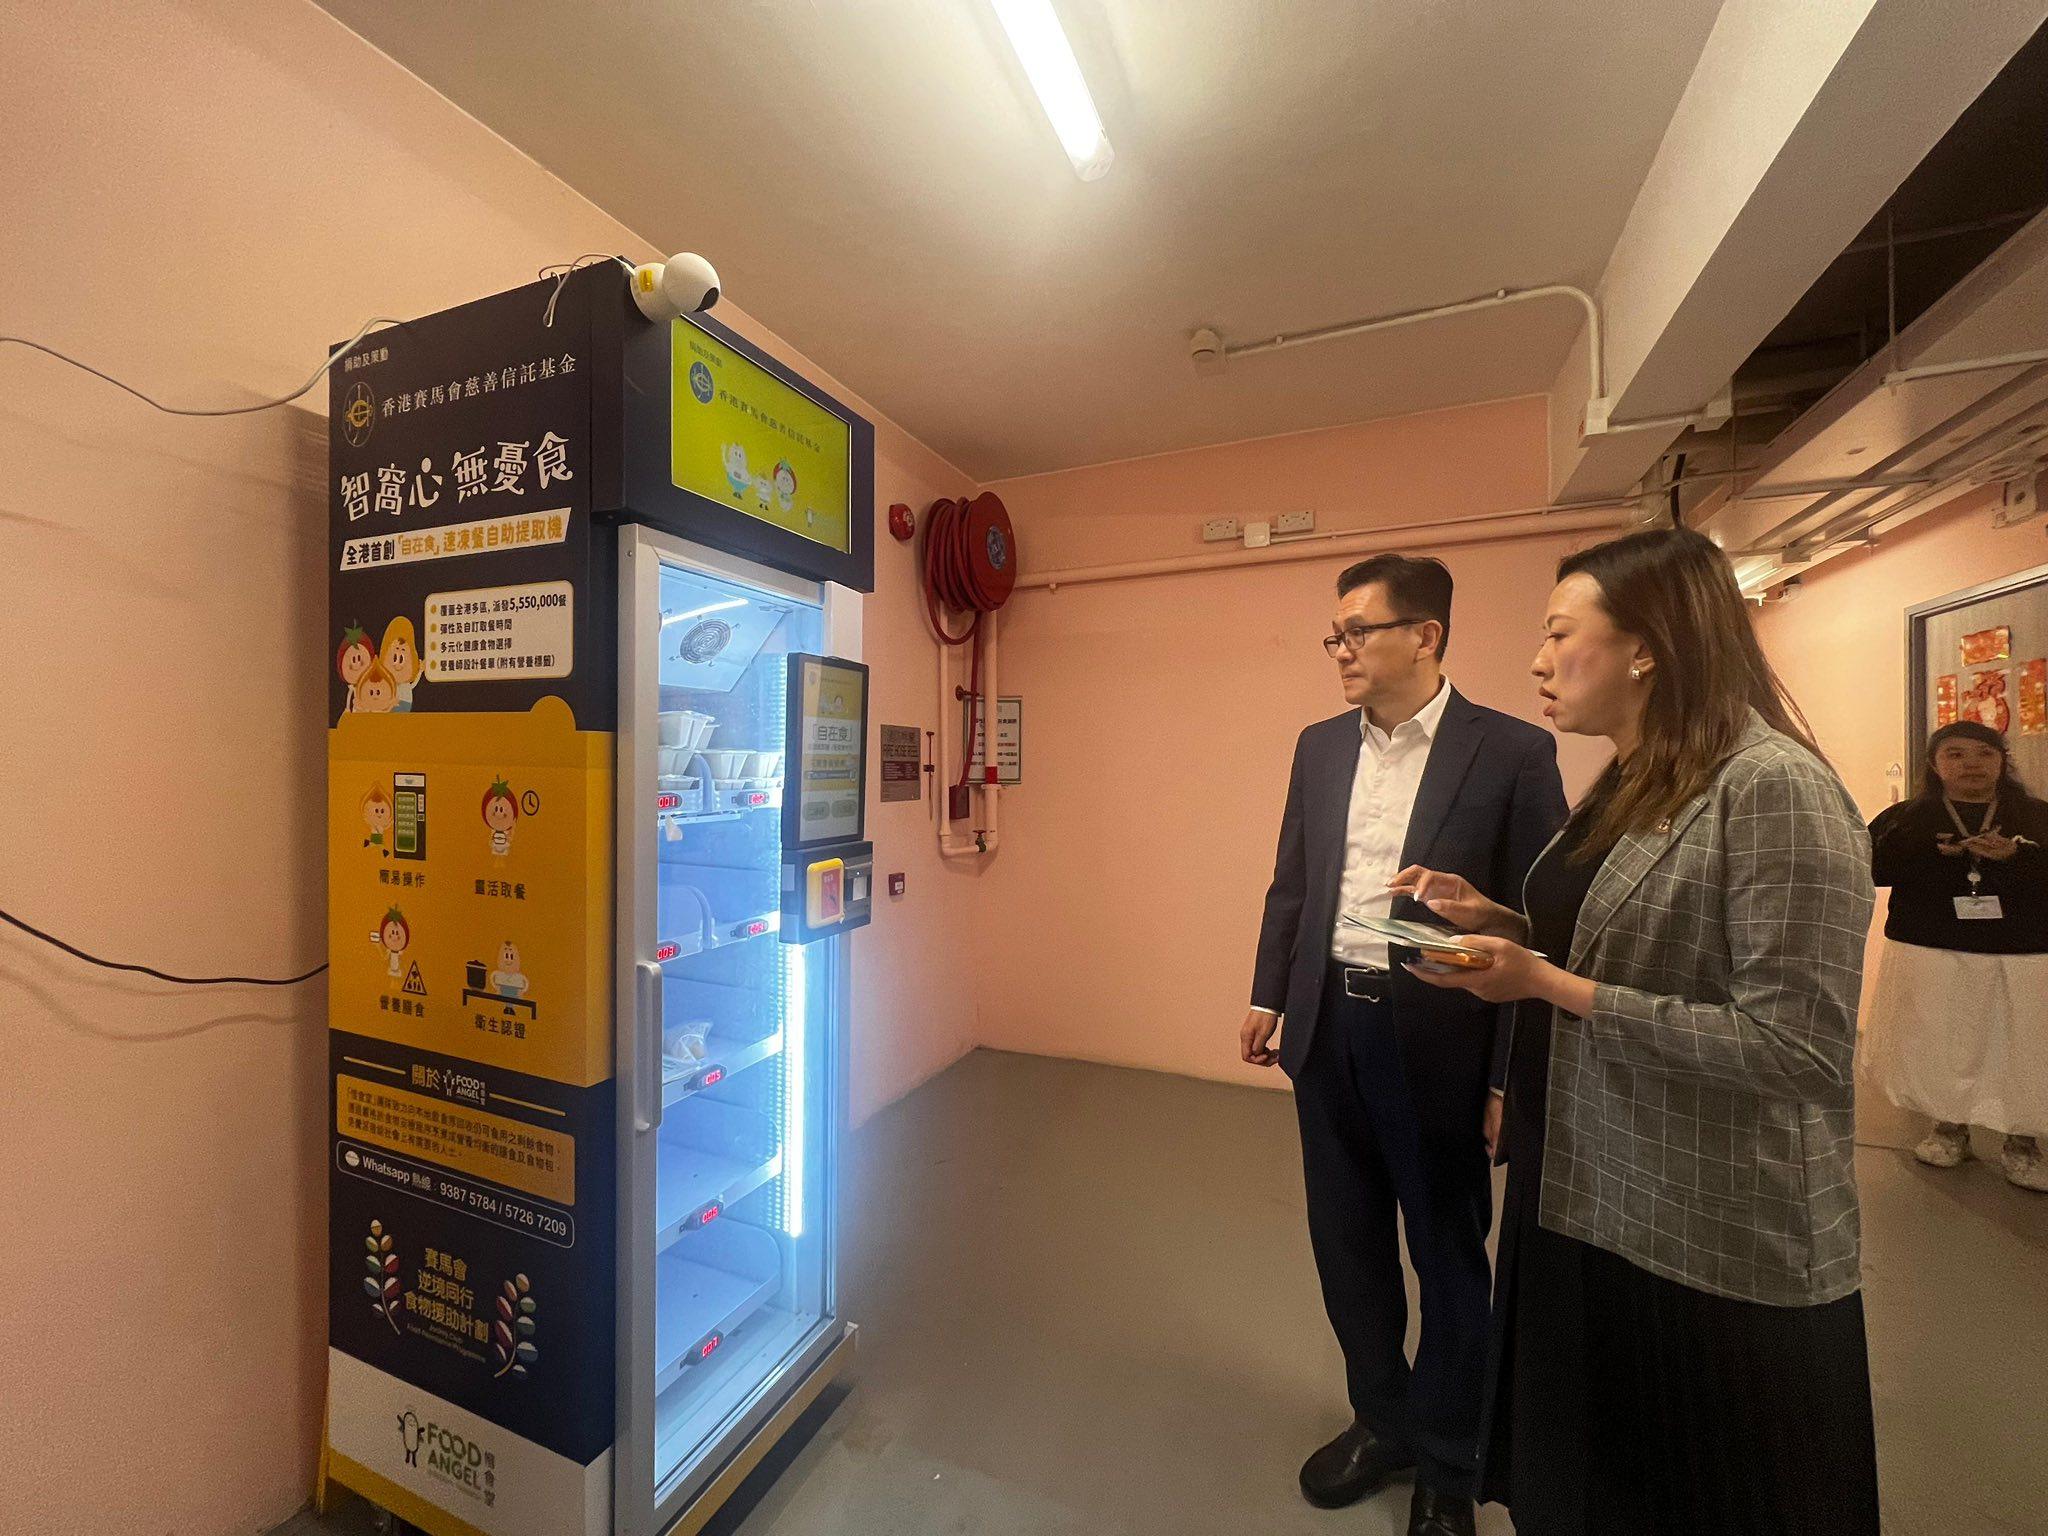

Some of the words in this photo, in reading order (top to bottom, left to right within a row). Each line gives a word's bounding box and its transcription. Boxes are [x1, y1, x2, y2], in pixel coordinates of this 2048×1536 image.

[382, 353, 577, 418] 香港賽馬會慈善信託基金
[440, 637, 513, 654] 多元化健康食物選擇
[379, 868, 426, 889] 簡易操作
[474, 879, 527, 901] 靈活取餐
[474, 1013, 527, 1040] 衛生認證
[411, 1063, 440, 1090] 關於
[455, 1074, 480, 1090] FOOD
[455, 1086, 480, 1100] ANGEL
[362, 1155, 411, 1184] Whatsapp
[440, 1182, 466, 1203] 9387
[468, 1191, 496, 1214] 5784
[505, 1203, 534, 1226] 5726
[536, 1214, 567, 1237] 7209
[424, 1247, 468, 1282] 賽馬會
[417, 1269, 475, 1311] 逆境同行
[404, 1289, 489, 1344] 食物援助計劃
[427, 1421, 482, 1469] FOOD
[427, 1448, 482, 1491] ANGEL
